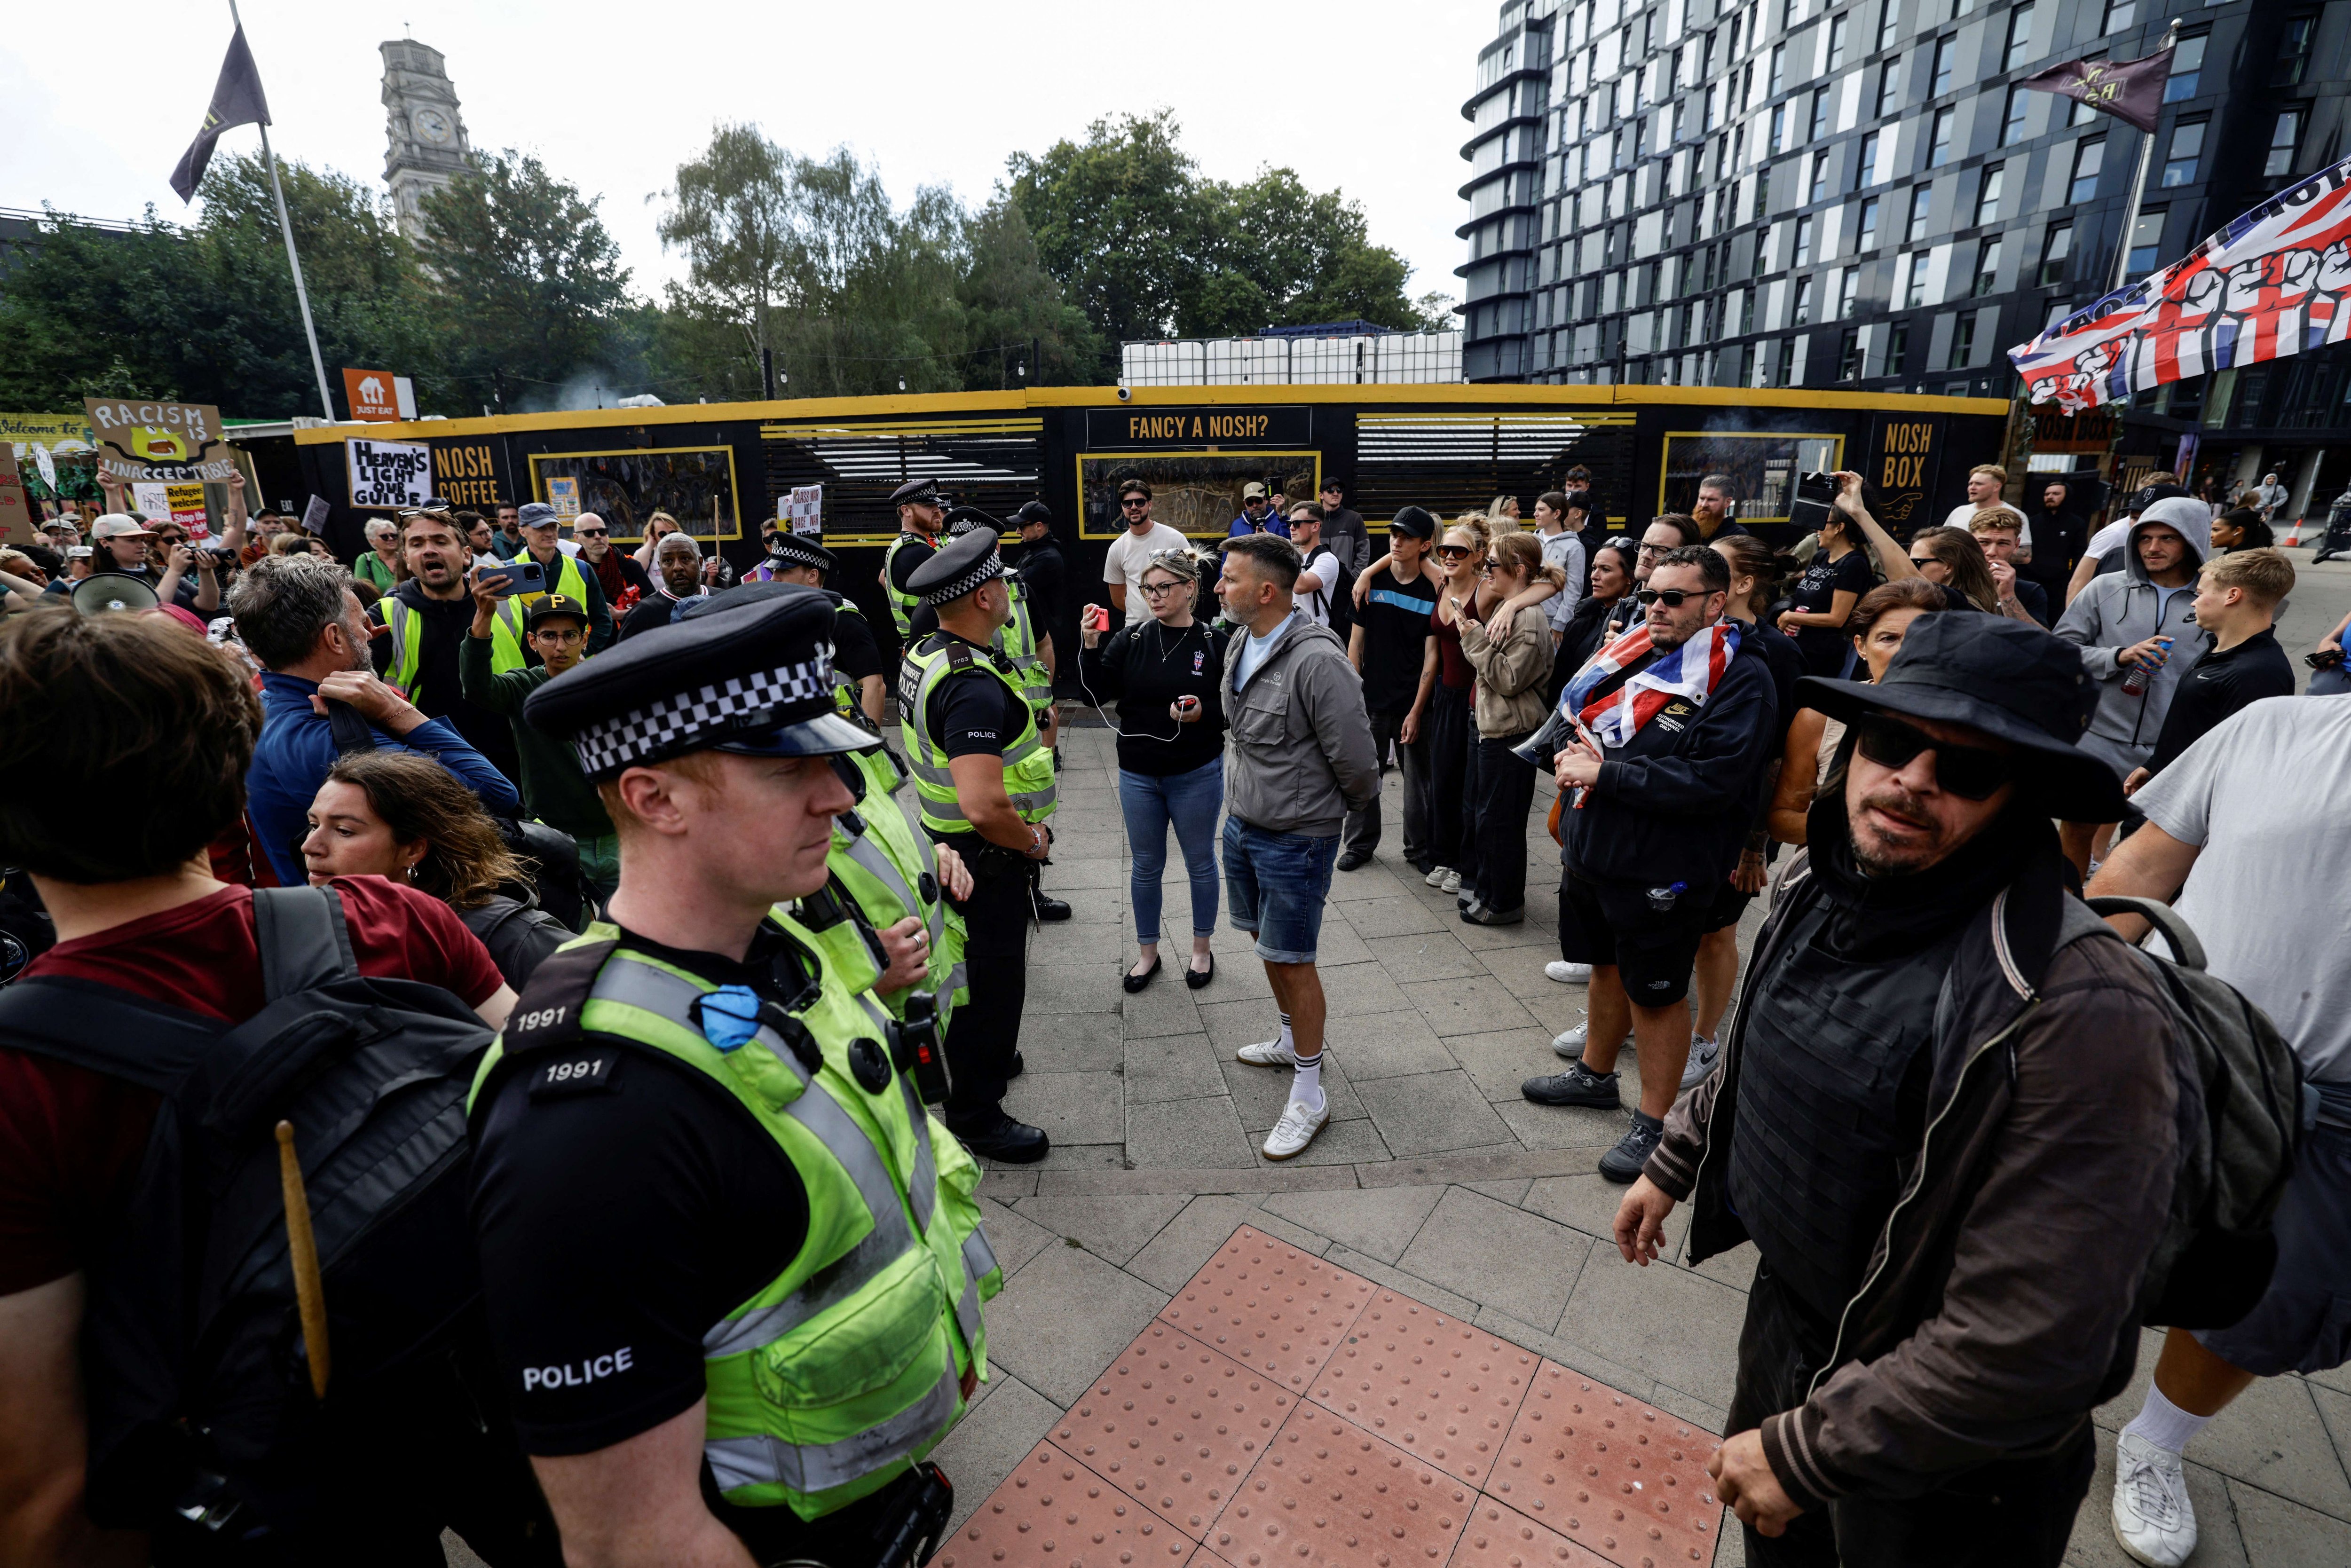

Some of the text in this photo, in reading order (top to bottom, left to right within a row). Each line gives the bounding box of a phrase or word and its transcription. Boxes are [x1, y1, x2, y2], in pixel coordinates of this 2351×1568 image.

[95, 404, 204, 428] RACISM
[356, 406, 377, 415] JUST
[58, 421, 83, 434] to
[1130, 415, 1268, 438] FANCY A NOSH?
[2075, 415, 2112, 441] BOX
[1884, 423, 1933, 453] NOSH
[104, 459, 232, 480] UNACCEPTABLE
[435, 446, 493, 478] NOSH
[360, 466, 415, 482] LIGHT
[1882, 456, 1925, 488] BOX
[167, 487, 203, 497] Refugees
[373, 481, 405, 494] OUR
[439, 480, 500, 505] COFFEE
[810, 489, 819, 502] WAR
[170, 498, 204, 508] welcome
[355, 490, 420, 506] GUIDE
[173, 511, 206, 525] Stop the
[795, 516, 806, 529] RACE
[810, 514, 818, 527] WAR
[191, 522, 208, 534] right
[550, 595, 565, 608] P
[906, 665, 921, 682] TRANSPORT
[899, 672, 917, 702] POLICE
[899, 700, 908, 721] OSU
[1671, 703, 1689, 713] NIKE
[1655, 717, 1680, 733] PERSONNEL
[1657, 713, 1684, 729] AUTHORIZED
[518, 1006, 566, 1032] 1991
[547, 1059, 602, 1082] 1991
[523, 1346, 634, 1392] POLICE
